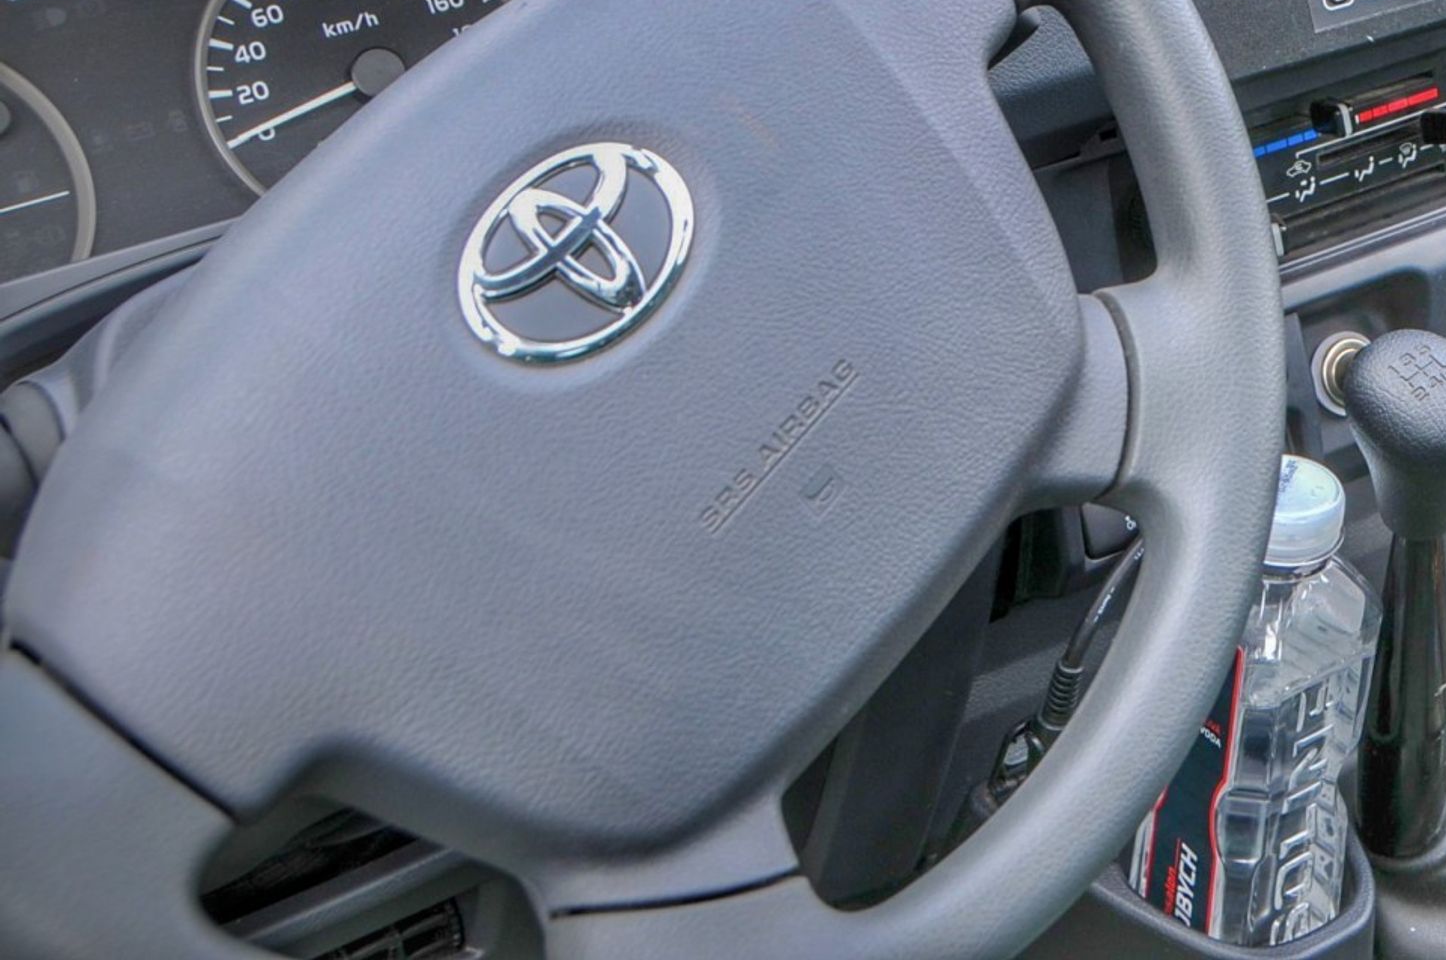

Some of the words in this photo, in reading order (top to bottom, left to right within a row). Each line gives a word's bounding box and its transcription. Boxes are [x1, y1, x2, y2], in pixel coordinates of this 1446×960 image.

[251, 4, 284, 27] 60
[322, 12, 379, 38] km/h
[234, 41, 267, 63] 40
[236, 81, 269, 105] 20
[701, 468, 757, 530] SRS
[757, 358, 855, 467] AIRBAG
[1174, 842, 1198, 928] JBYCH
